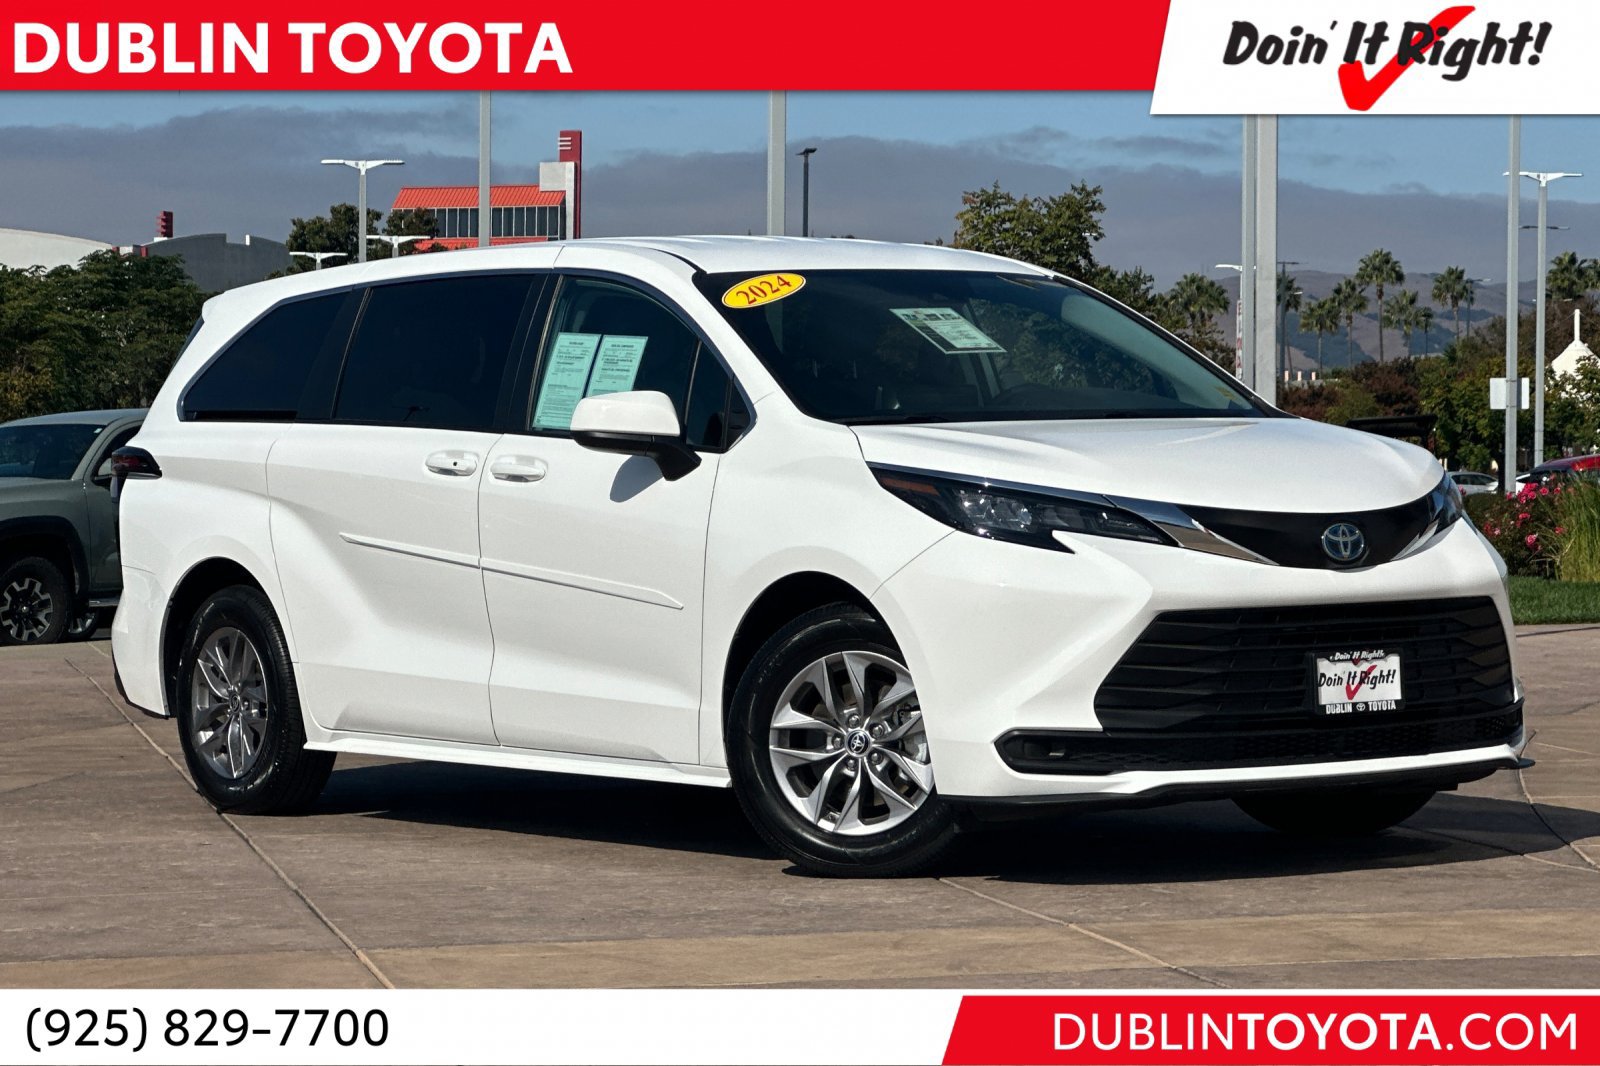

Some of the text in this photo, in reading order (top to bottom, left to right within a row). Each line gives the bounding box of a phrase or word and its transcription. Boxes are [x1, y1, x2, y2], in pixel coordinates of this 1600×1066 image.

[736, 275, 792, 305] 2024
[1346, 671, 1357, 686] It
[1359, 669, 1396, 690] Right!
[1325, 700, 1396, 714] DUBLIN TOYOTA
